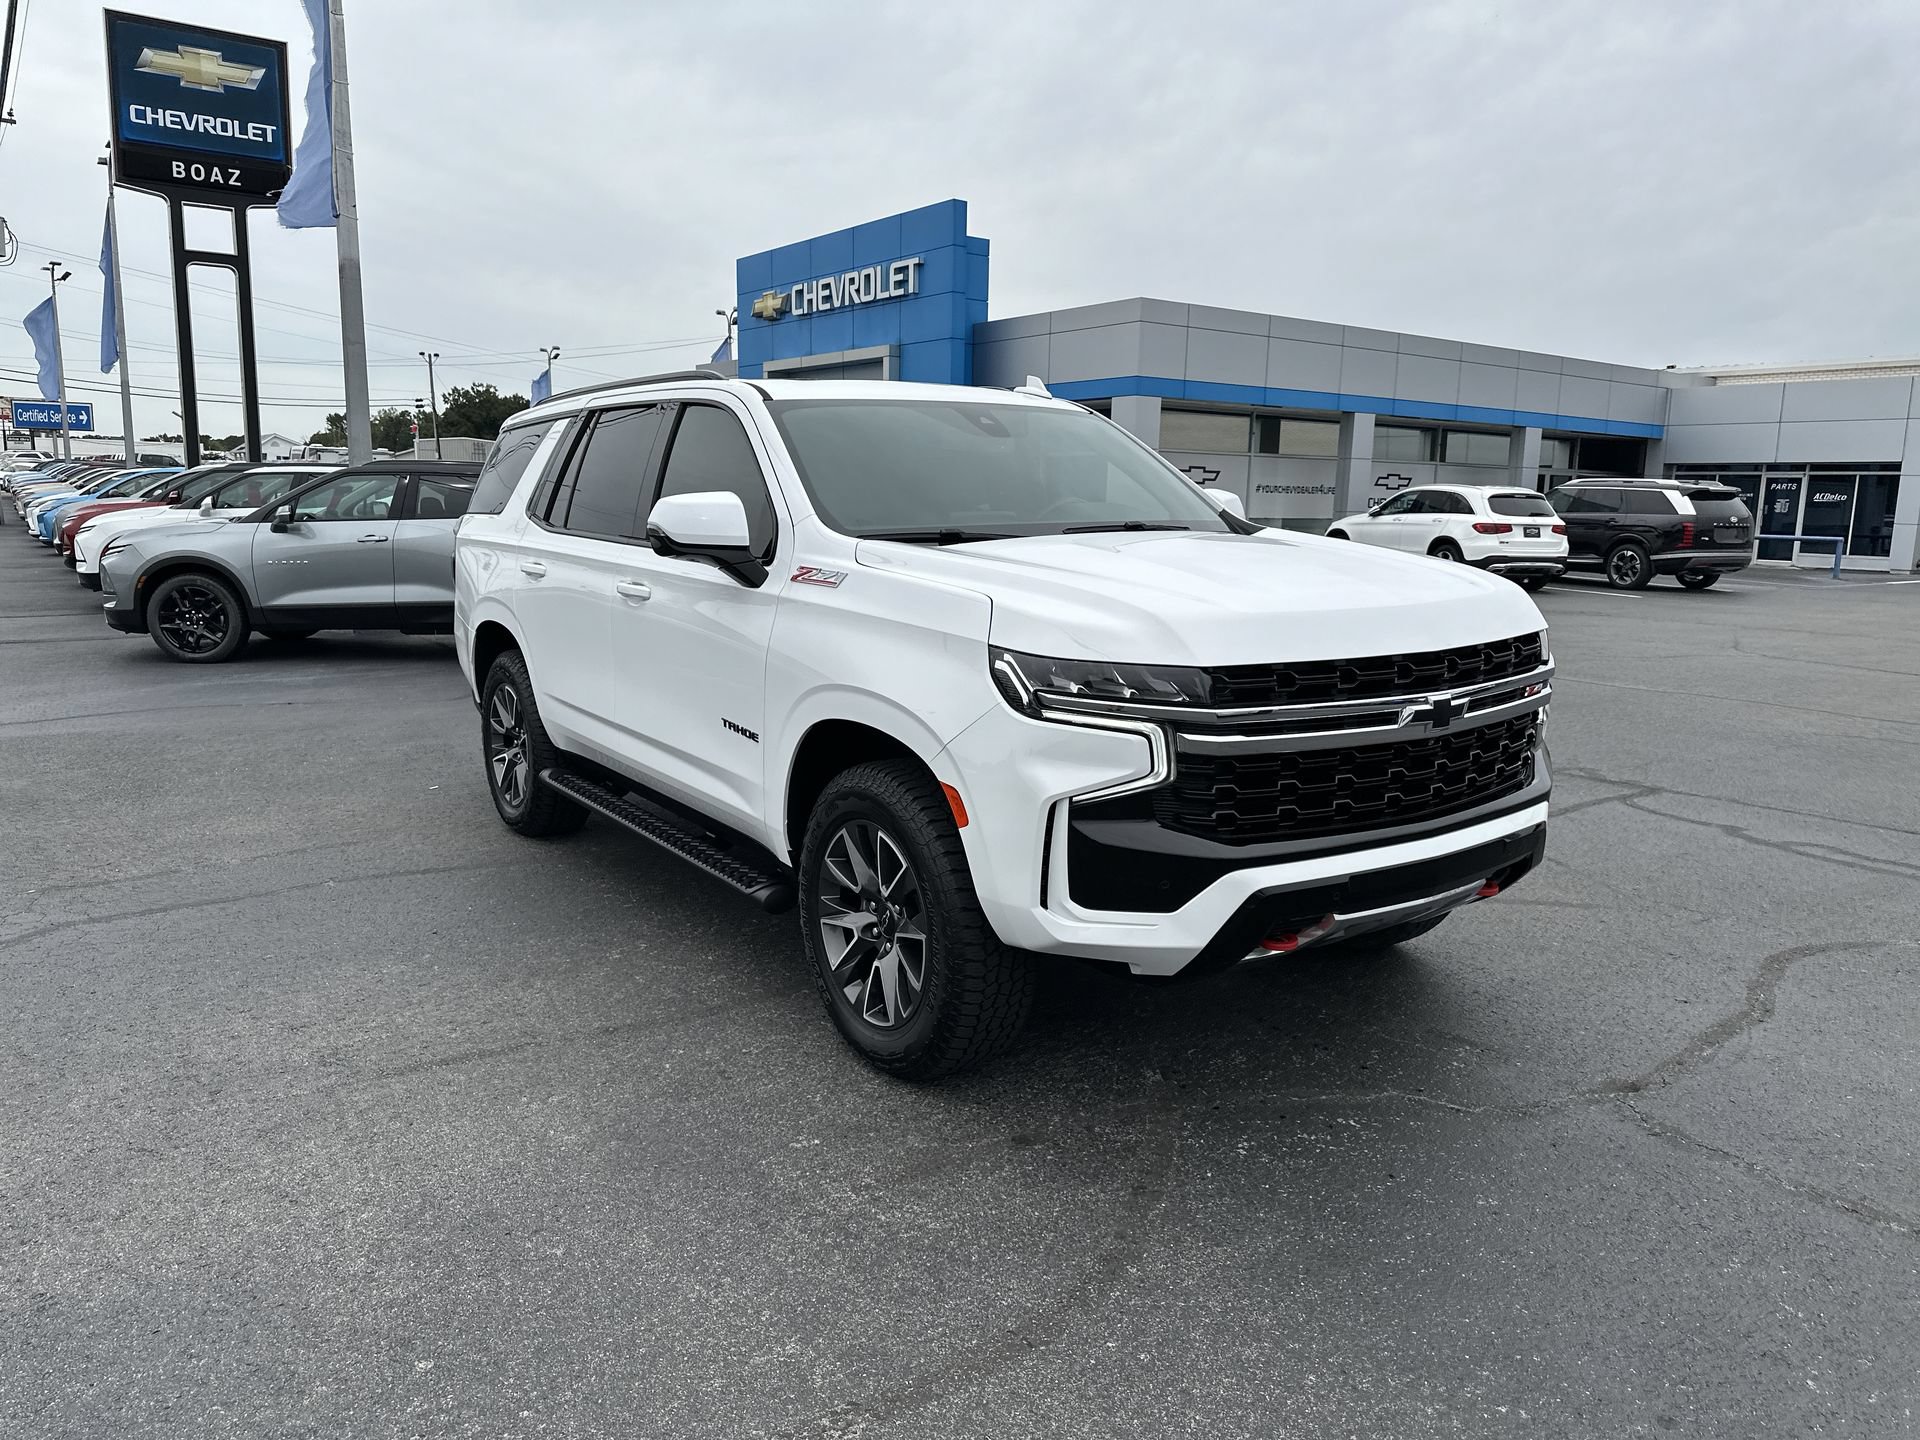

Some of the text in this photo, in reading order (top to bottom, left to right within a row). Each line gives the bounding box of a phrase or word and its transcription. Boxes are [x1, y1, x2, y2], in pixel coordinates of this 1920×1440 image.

[129, 104, 276, 143] CHEVROLET
[172, 161, 241, 186] BOAZ
[791, 257, 922, 316] CHEVROLET
[17, 408, 76, 424] Certified Serce
[1255, 484, 1336, 495] #YOURCHEVYDEALER4LIFE
[1770, 483, 1797, 491] PARTS
[1813, 492, 1848, 502] ACDelco
[790, 565, 848, 588] Z71
[720, 717, 759, 743] TAHOE
